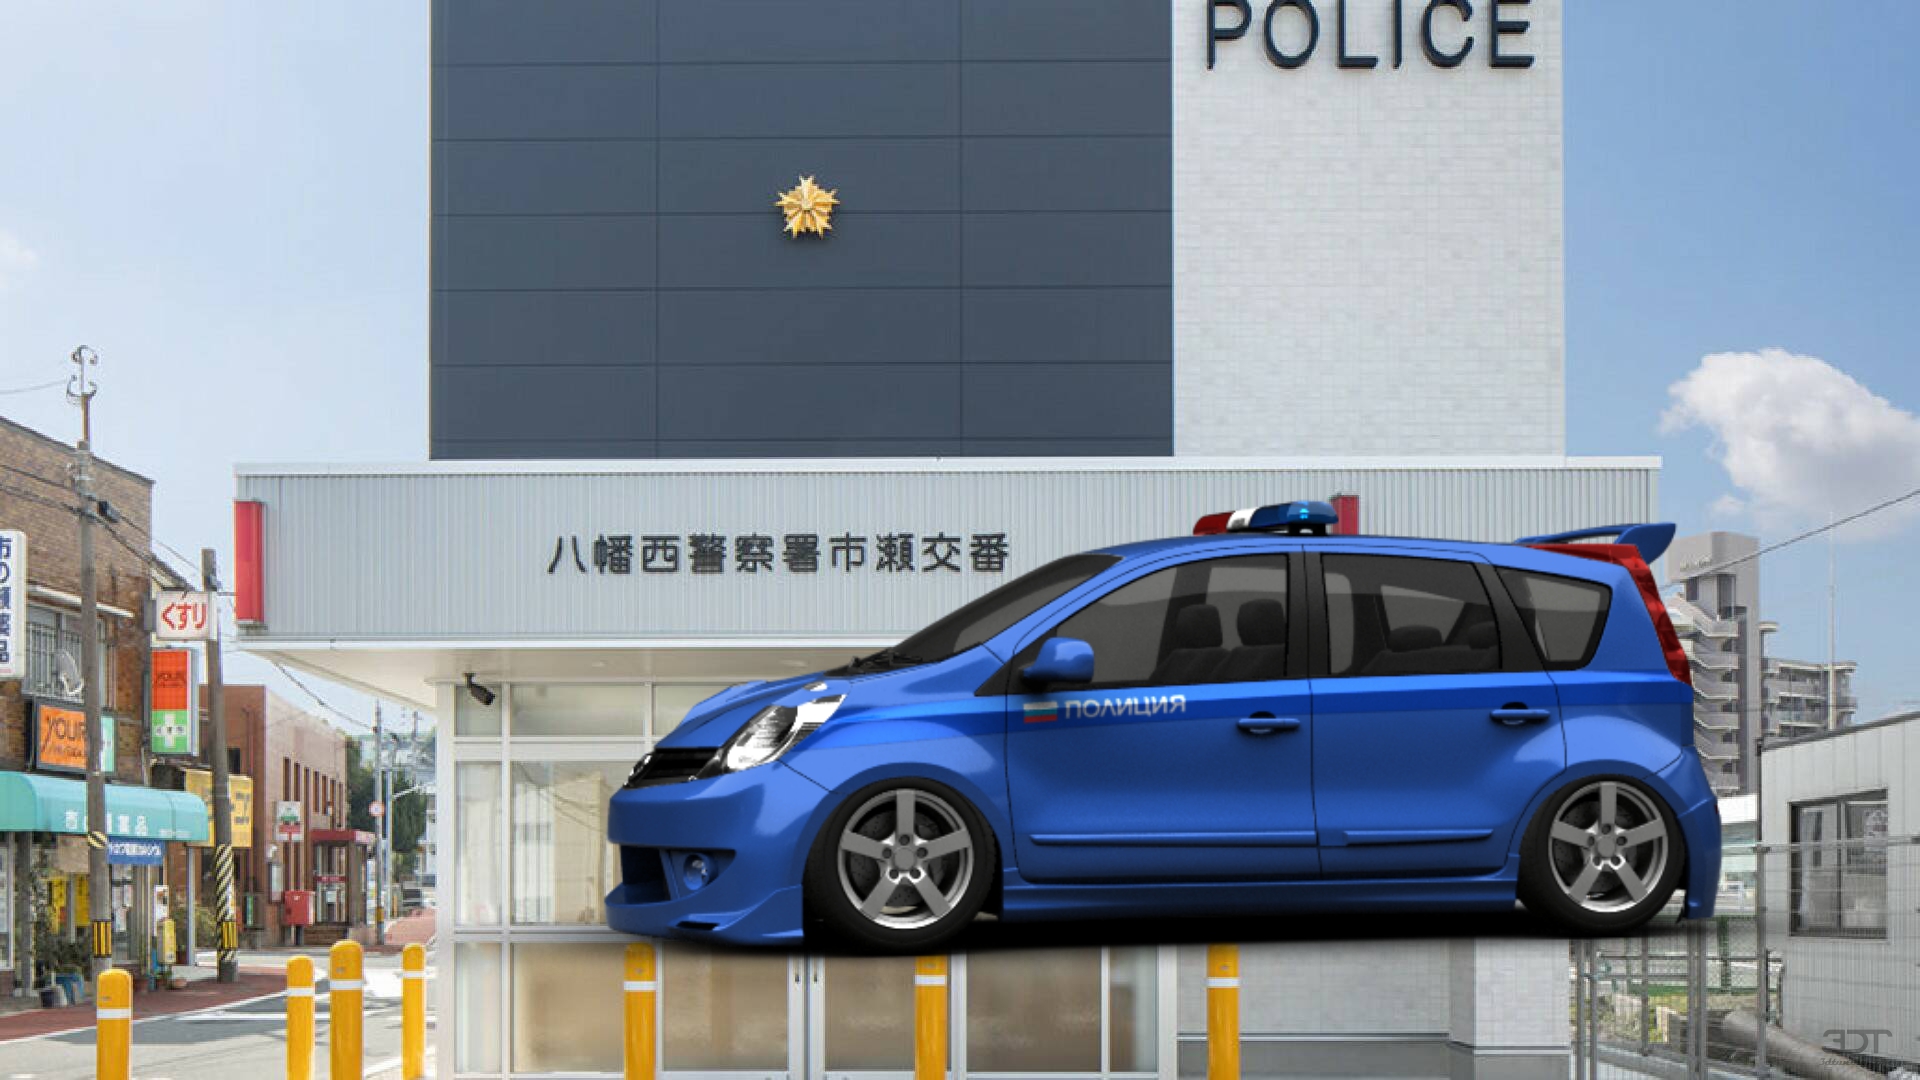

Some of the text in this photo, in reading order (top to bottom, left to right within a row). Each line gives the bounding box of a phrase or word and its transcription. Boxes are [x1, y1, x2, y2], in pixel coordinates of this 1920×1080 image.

[1206, 0, 1535, 70] POLICE
[547, 532, 1010, 575] 八幡西警察署市瀬交番
[161, 602, 207, 630] くすり
[1065, 694, 1186, 719] ПОЛИЦИЯ
